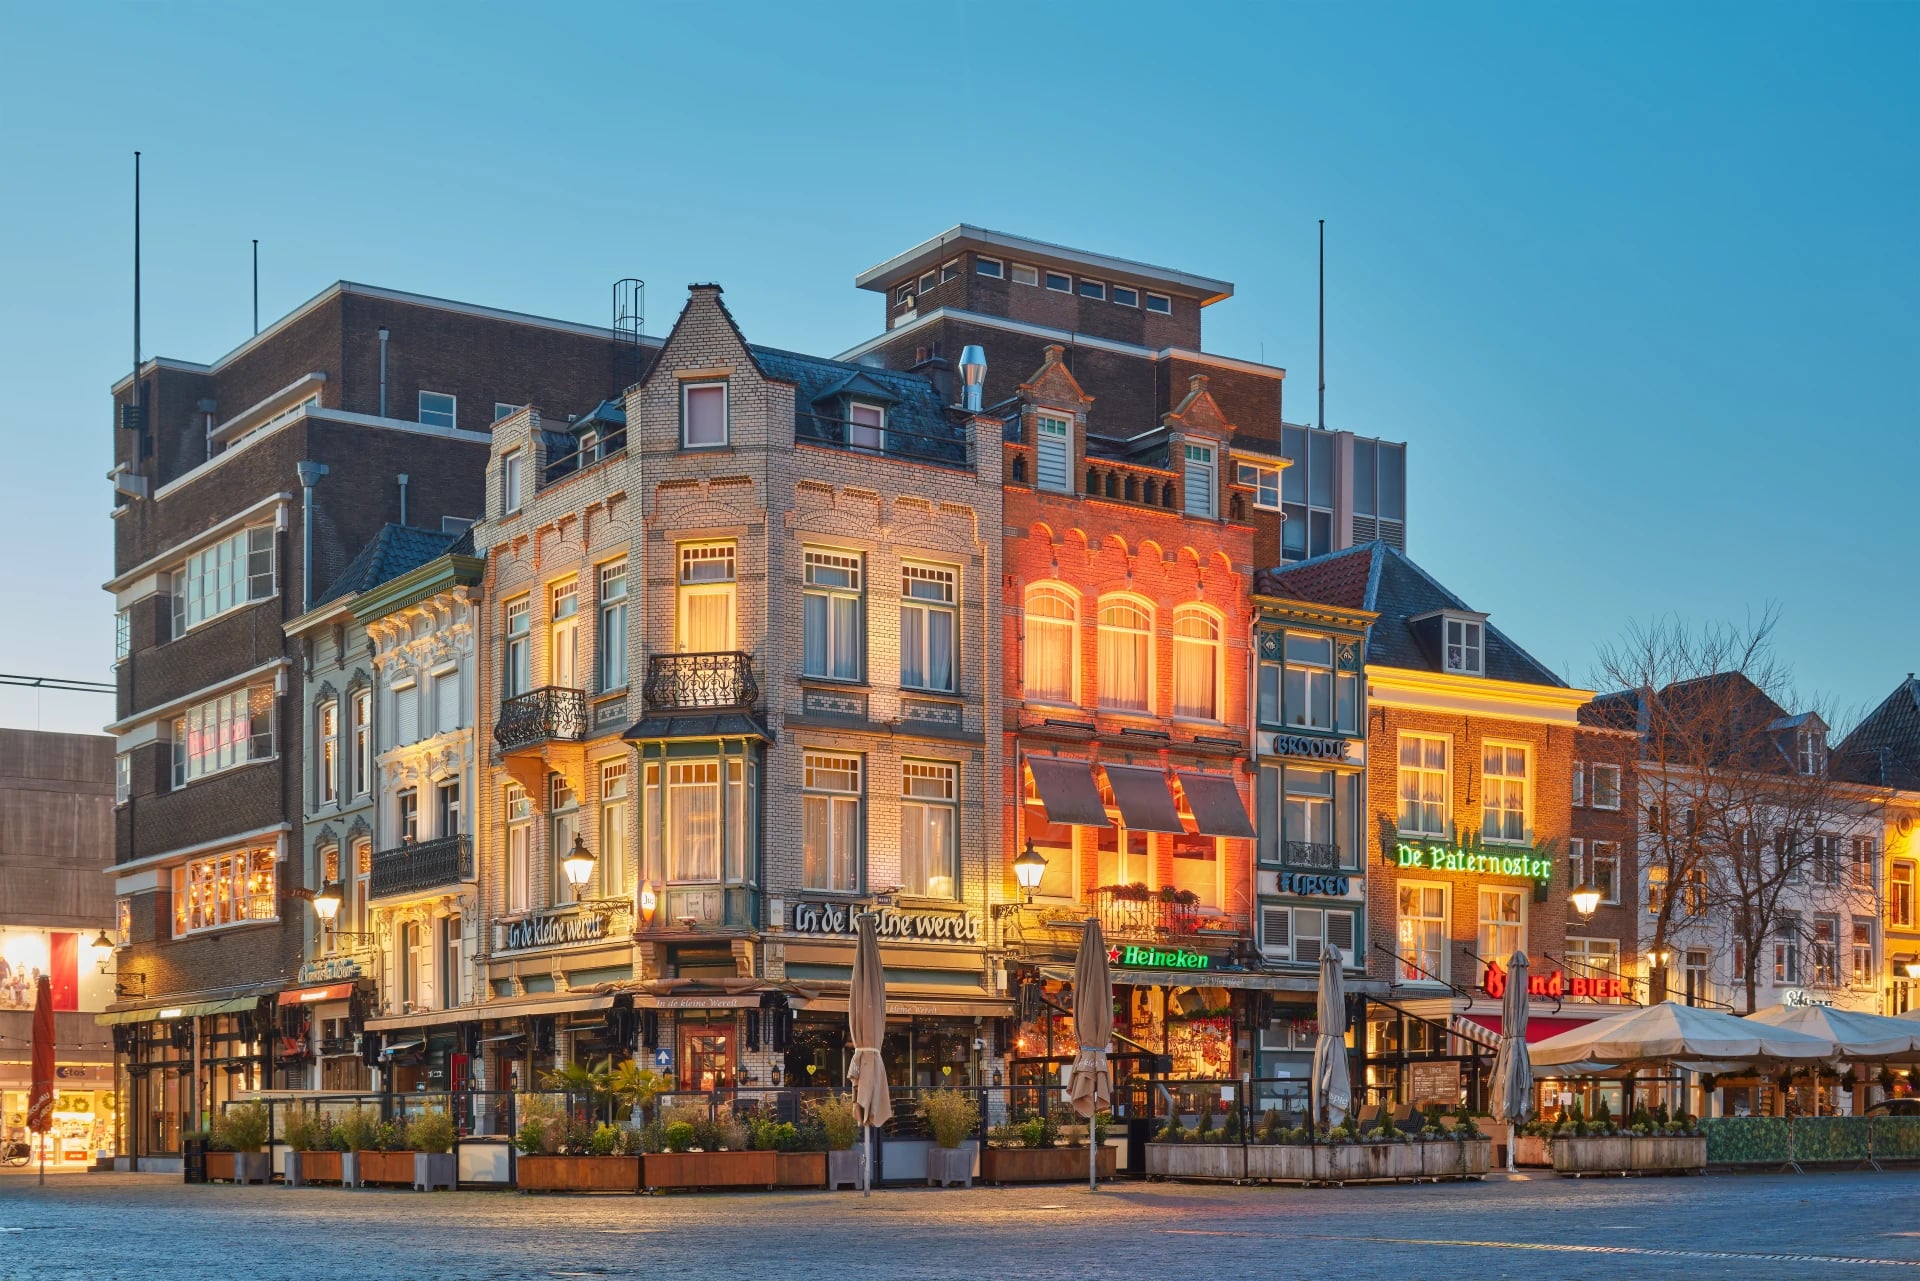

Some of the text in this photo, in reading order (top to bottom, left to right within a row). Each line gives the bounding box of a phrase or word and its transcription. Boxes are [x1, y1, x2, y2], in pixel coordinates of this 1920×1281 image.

[1275, 735, 1351, 760] BROODJE
[1396, 843, 1552, 879] De Paternoster
[1279, 872, 1350, 896] FLIPSEN
[521, 919, 533, 948] de
[533, 915, 565, 945] kleine
[566, 913, 604, 941] werelt
[795, 903, 817, 932] In
[822, 902, 845, 933] de
[915, 912, 985, 940] werelt
[1124, 945, 1209, 969] Heineken
[1486, 961, 1622, 999] Bnd BIER
[656, 998, 737, 1007] In de kleine Werelt
